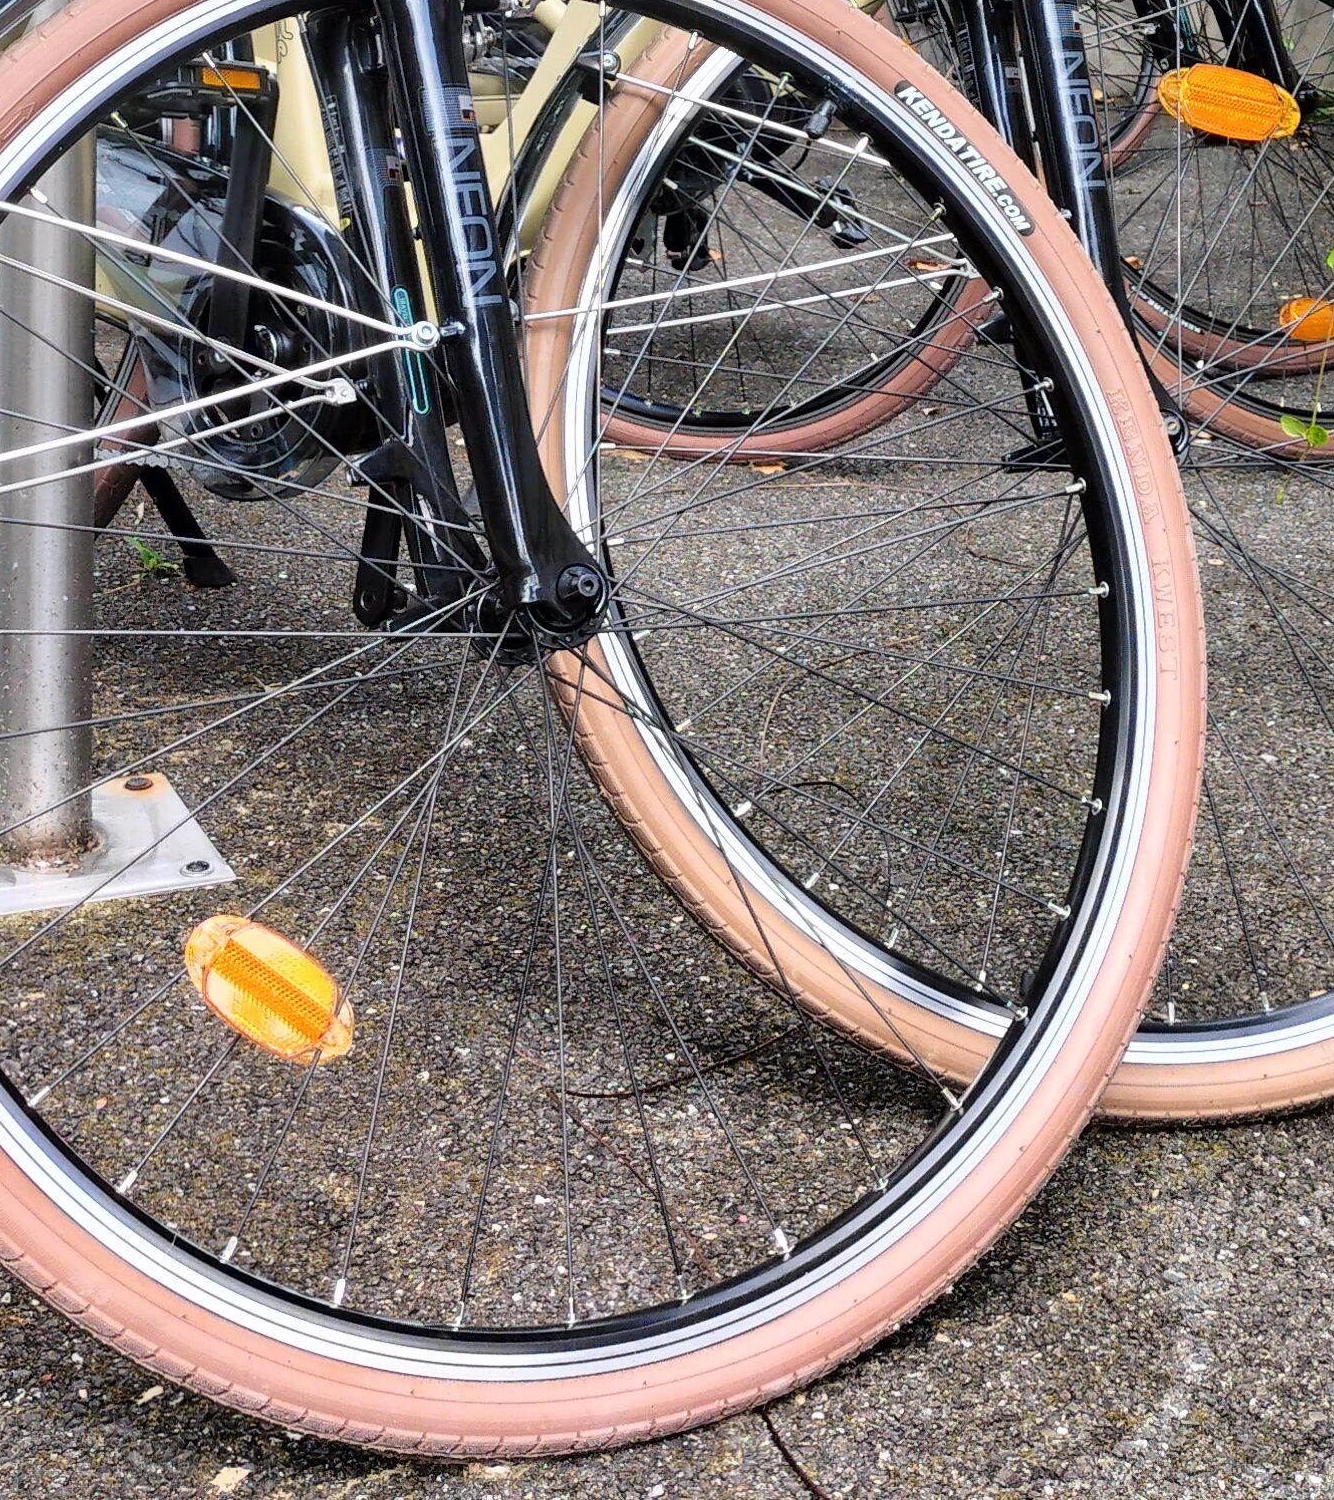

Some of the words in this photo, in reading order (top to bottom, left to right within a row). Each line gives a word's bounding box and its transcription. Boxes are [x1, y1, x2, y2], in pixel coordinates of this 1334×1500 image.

[897, 85, 1032, 231] KENDATIRE.COM
[1053, 51, 1107, 188] NEON
[433, 136, 503, 308] NEON
[1106, 387, 1159, 525] KENDA
[1151, 558, 1178, 682] KWEST
